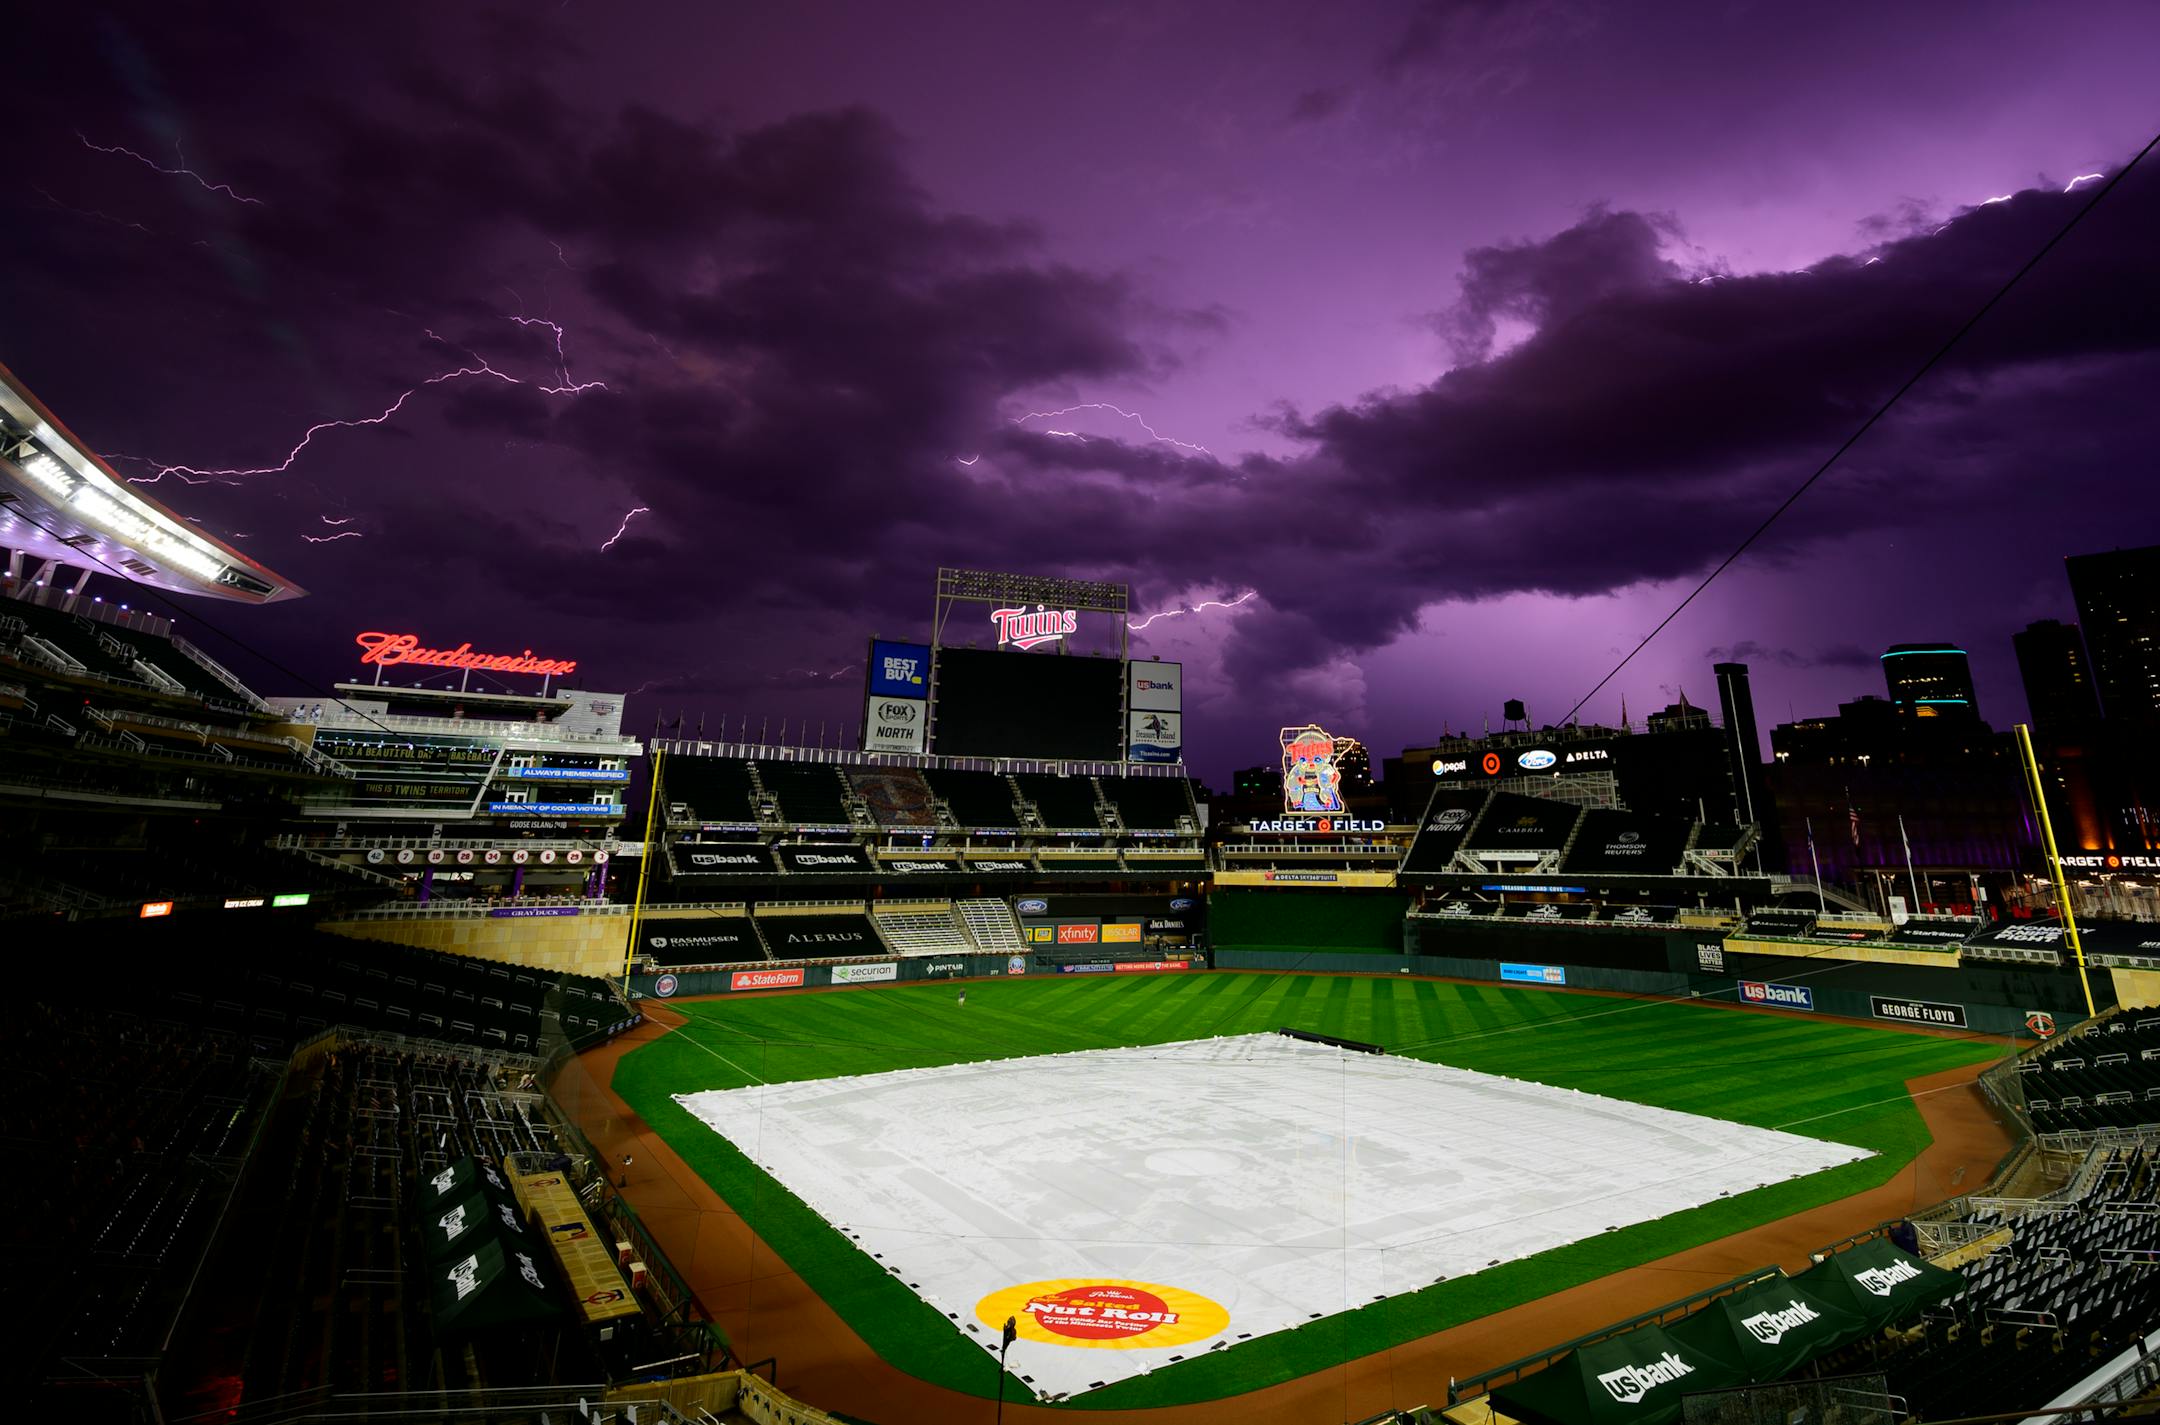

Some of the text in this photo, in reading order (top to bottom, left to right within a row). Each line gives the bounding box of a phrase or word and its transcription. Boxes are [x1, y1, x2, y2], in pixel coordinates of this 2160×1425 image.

[990, 604, 1078, 645] Twins
[356, 632, 577, 675] Budweiser
[884, 657, 918, 670] BEST
[885, 669, 914, 682] BUY
[886, 704, 908, 716] FOX
[876, 726, 914, 739] NORTH
[1136, 729, 1175, 740] Treasure Island
[333, 746, 354, 756] IT'S
[356, 747, 363, 756] A
[365, 747, 415, 759] BEAUTIFUL
[450, 751, 492, 762] BASEBALL
[1576, 750, 1608, 760] DELTA
[1444, 760, 1466, 773] pepsi
[562, 770, 625, 779] REMEMBERED
[365, 784, 470, 796] THIS IS TWINS TERRITORY
[1250, 820, 1384, 831] TARGET FIELD
[1426, 824, 1465, 832] NORTH
[1150, 919, 1184, 929] JACK DANIEL'S
[788, 932, 863, 943] ALERUS
[1060, 926, 1096, 942] xfinity
[1994, 933, 2059, 942] FIGHT
[671, 935, 739, 945] RASMUSSEN
[1697, 944, 1721, 952] BLACK
[1699, 951, 1721, 960] LIVES
[1699, 958, 1723, 966] MATTER
[850, 965, 892, 977] securian
[1882, 1003, 1956, 1023] GEORGE FLOYD
[1069, 1299, 1140, 1310] Salted
[1025, 1302, 1175, 1324] Nut Roll
[1070, 1321, 1113, 1329] Minnesota
[1115, 1320, 1149, 1328] Partner
